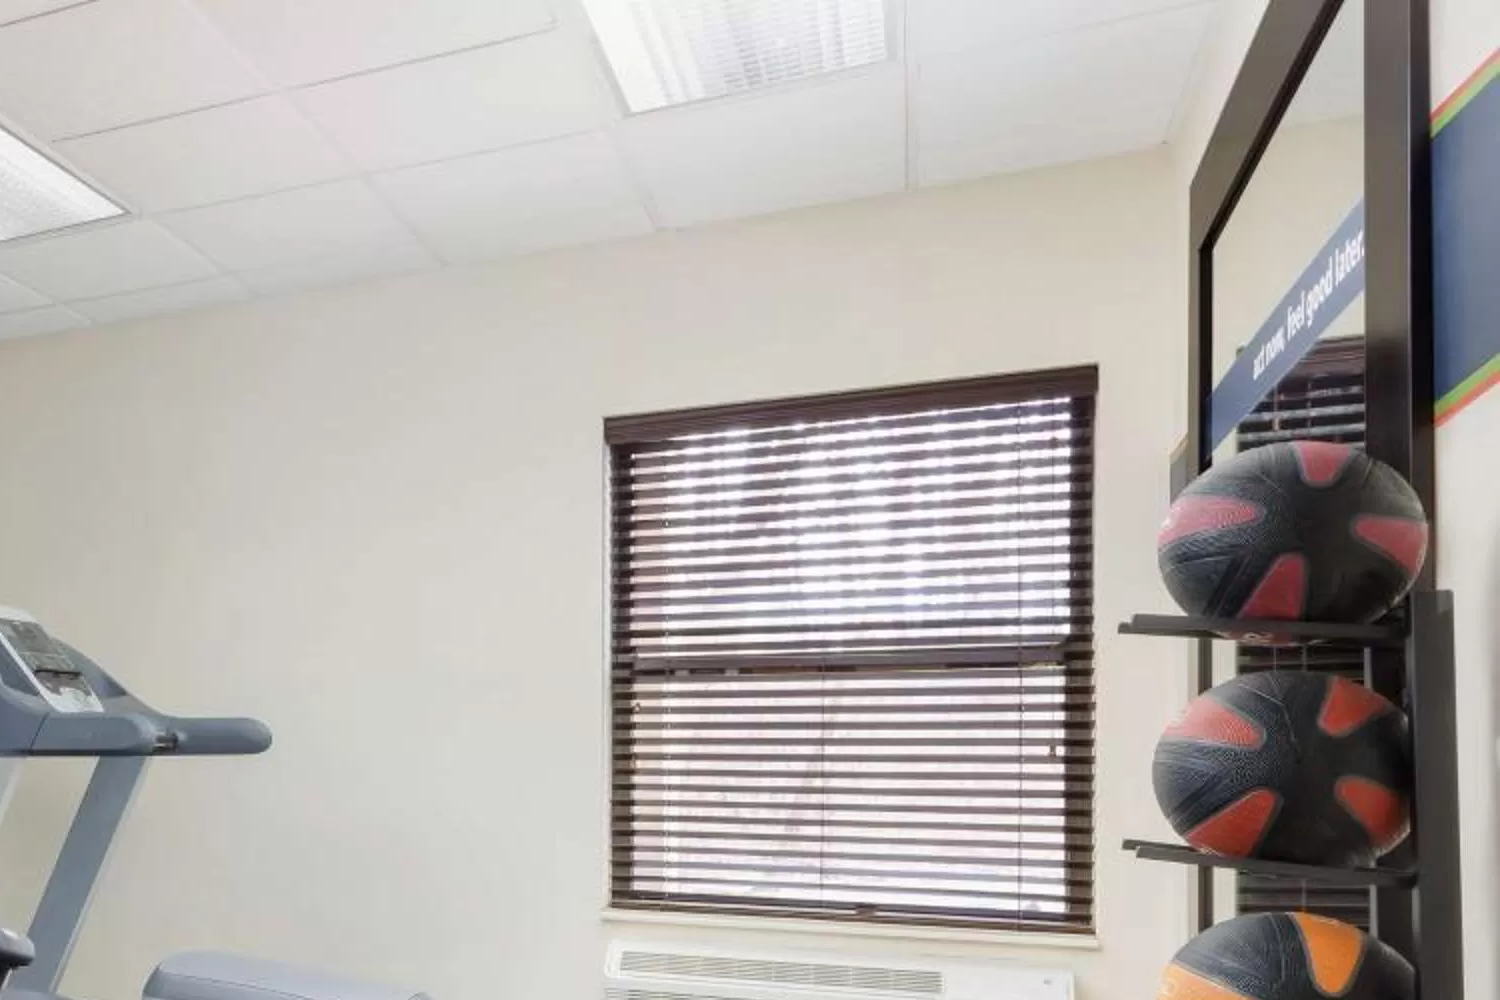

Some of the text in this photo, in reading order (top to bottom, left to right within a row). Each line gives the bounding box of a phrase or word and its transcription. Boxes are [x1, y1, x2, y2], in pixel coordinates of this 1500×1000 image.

[1287, 290, 1305, 342] feel
[1307, 256, 1333, 328] good
[1335, 229, 1365, 287] later.
